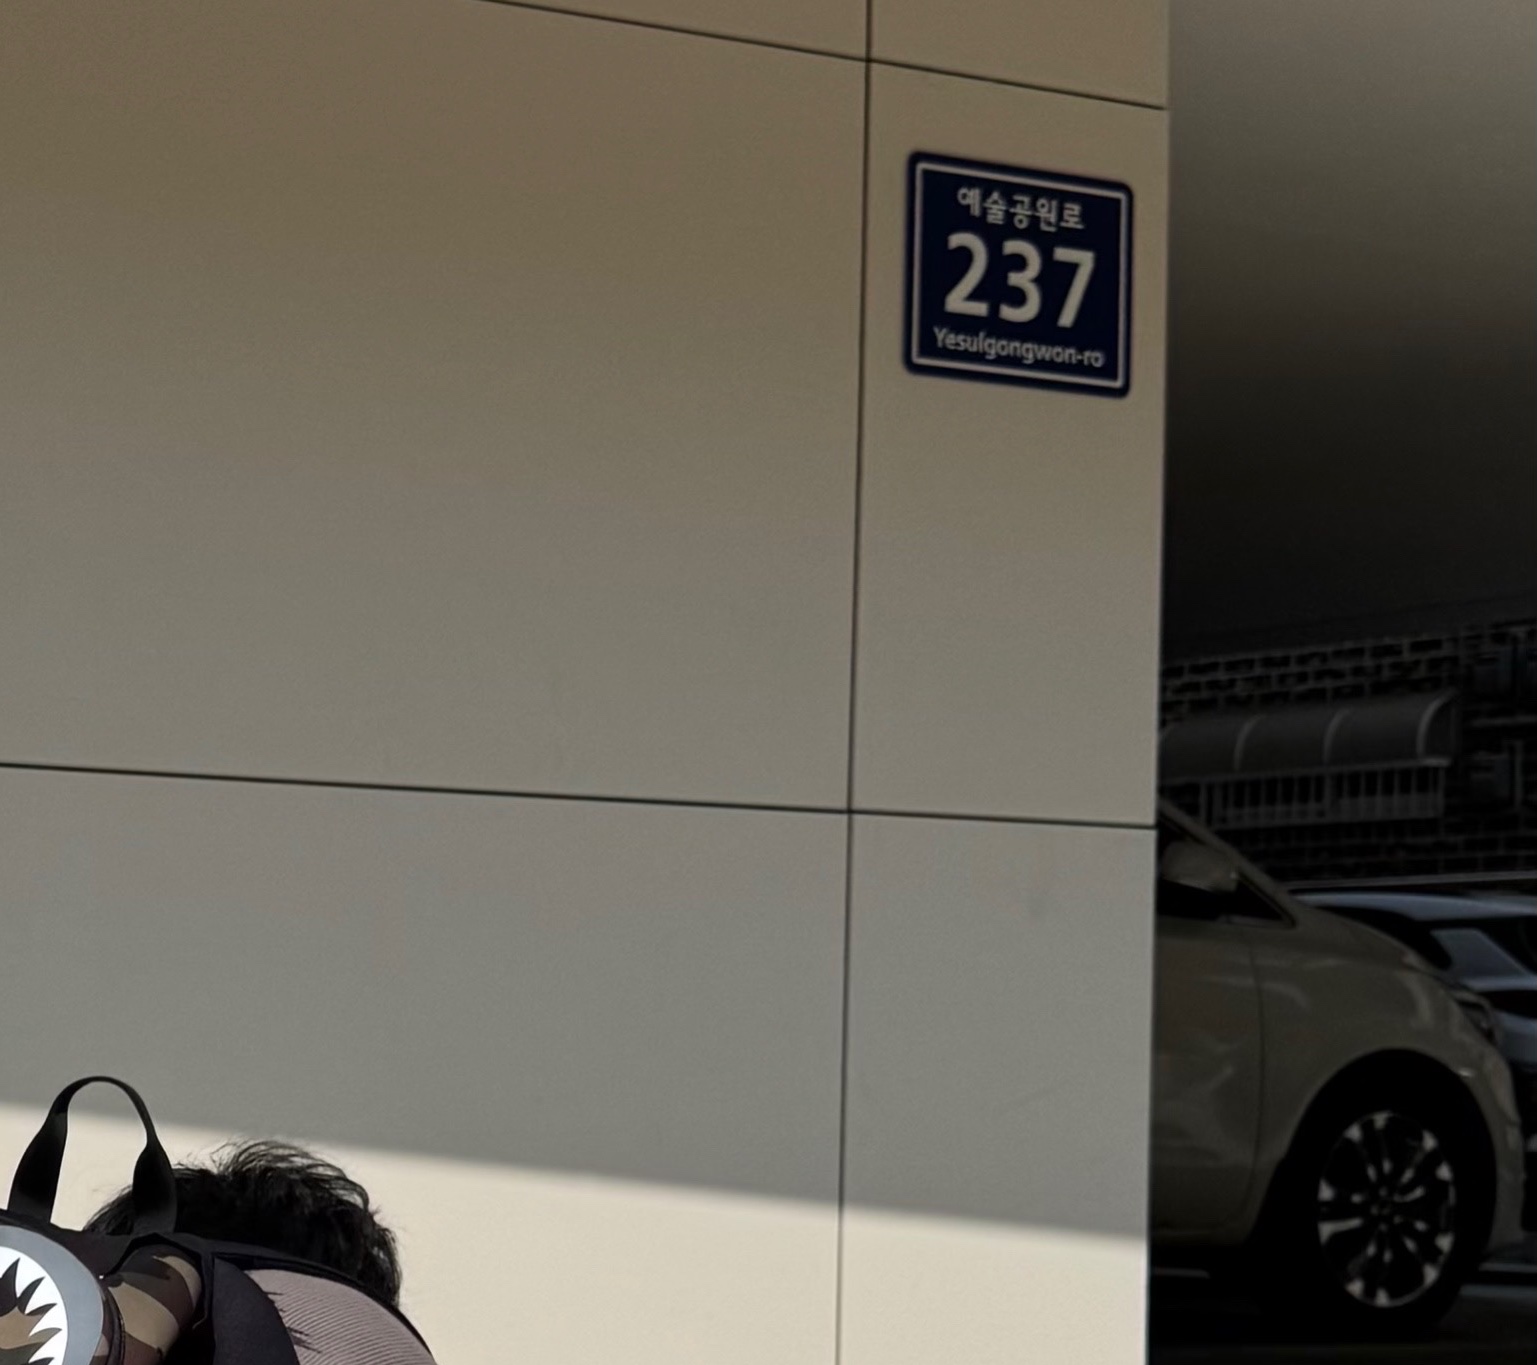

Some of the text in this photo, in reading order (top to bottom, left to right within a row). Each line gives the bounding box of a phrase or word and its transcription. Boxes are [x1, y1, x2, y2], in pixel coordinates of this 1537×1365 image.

[957, 187, 1085, 233] 예술공원로
[944, 232, 1096, 329] 237
[932, 326, 1106, 368] Yesulgongwon-ro
